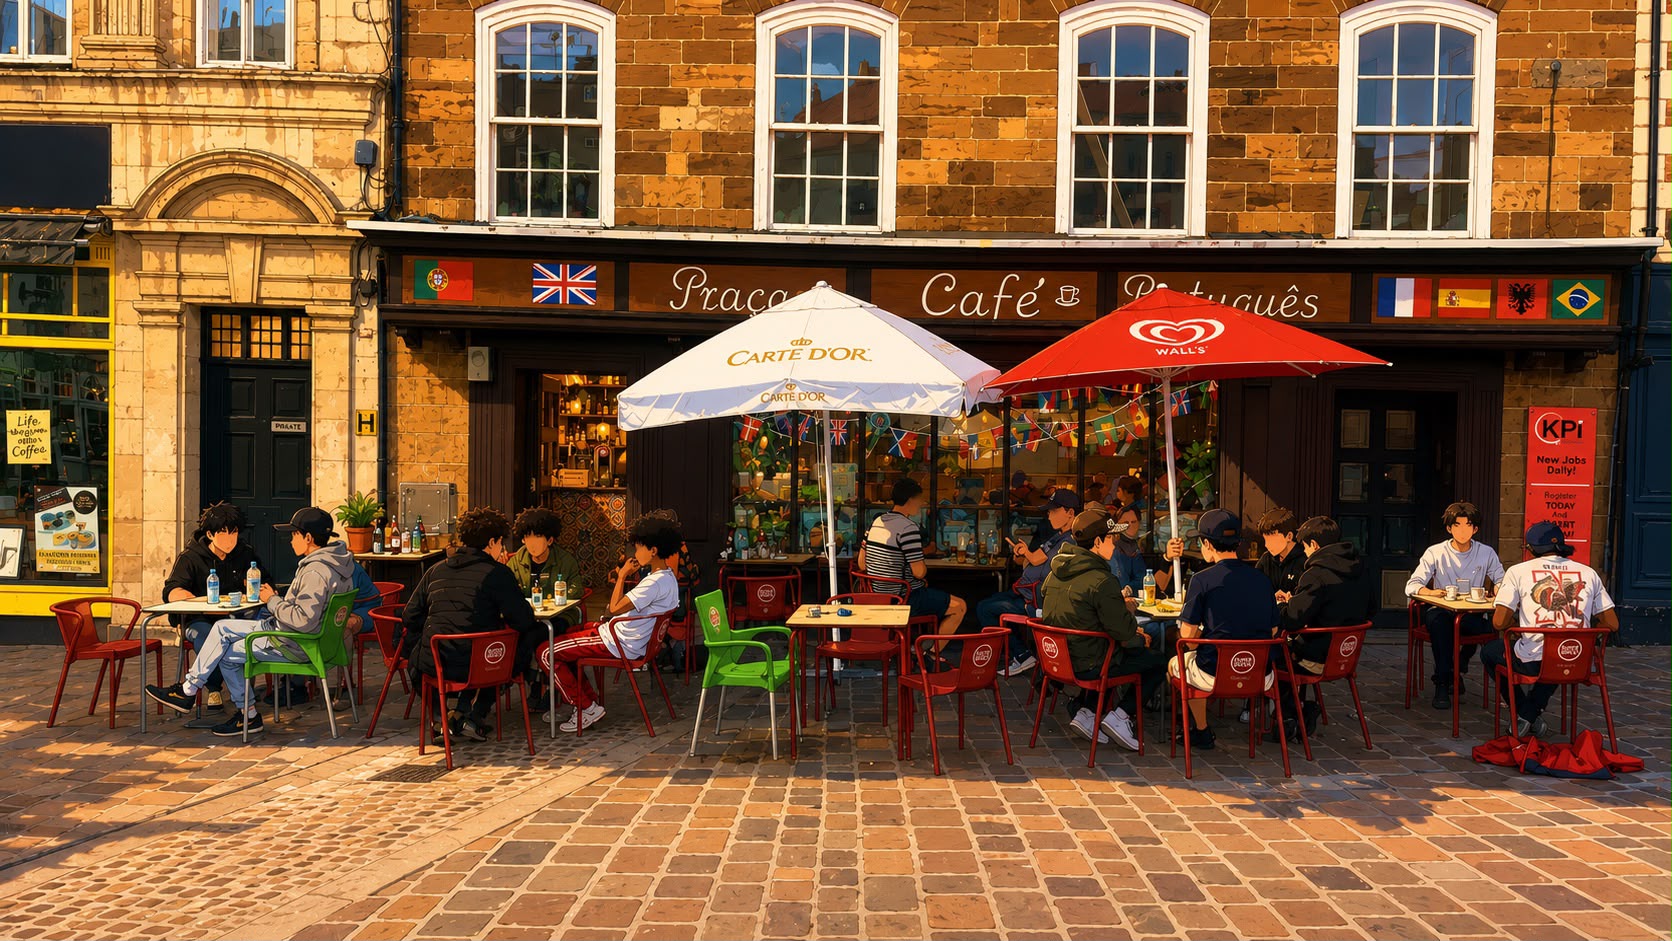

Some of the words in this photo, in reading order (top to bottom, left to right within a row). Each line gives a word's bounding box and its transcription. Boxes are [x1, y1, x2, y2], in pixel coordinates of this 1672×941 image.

[921, 272, 1045, 320] Café
[727, 348, 803, 367] CARTE
[357, 413, 375, 433] H
[1536, 455, 1560, 464] New
[1562, 455, 1587, 465] Jobs
[1545, 501, 1576, 510] TODAY
